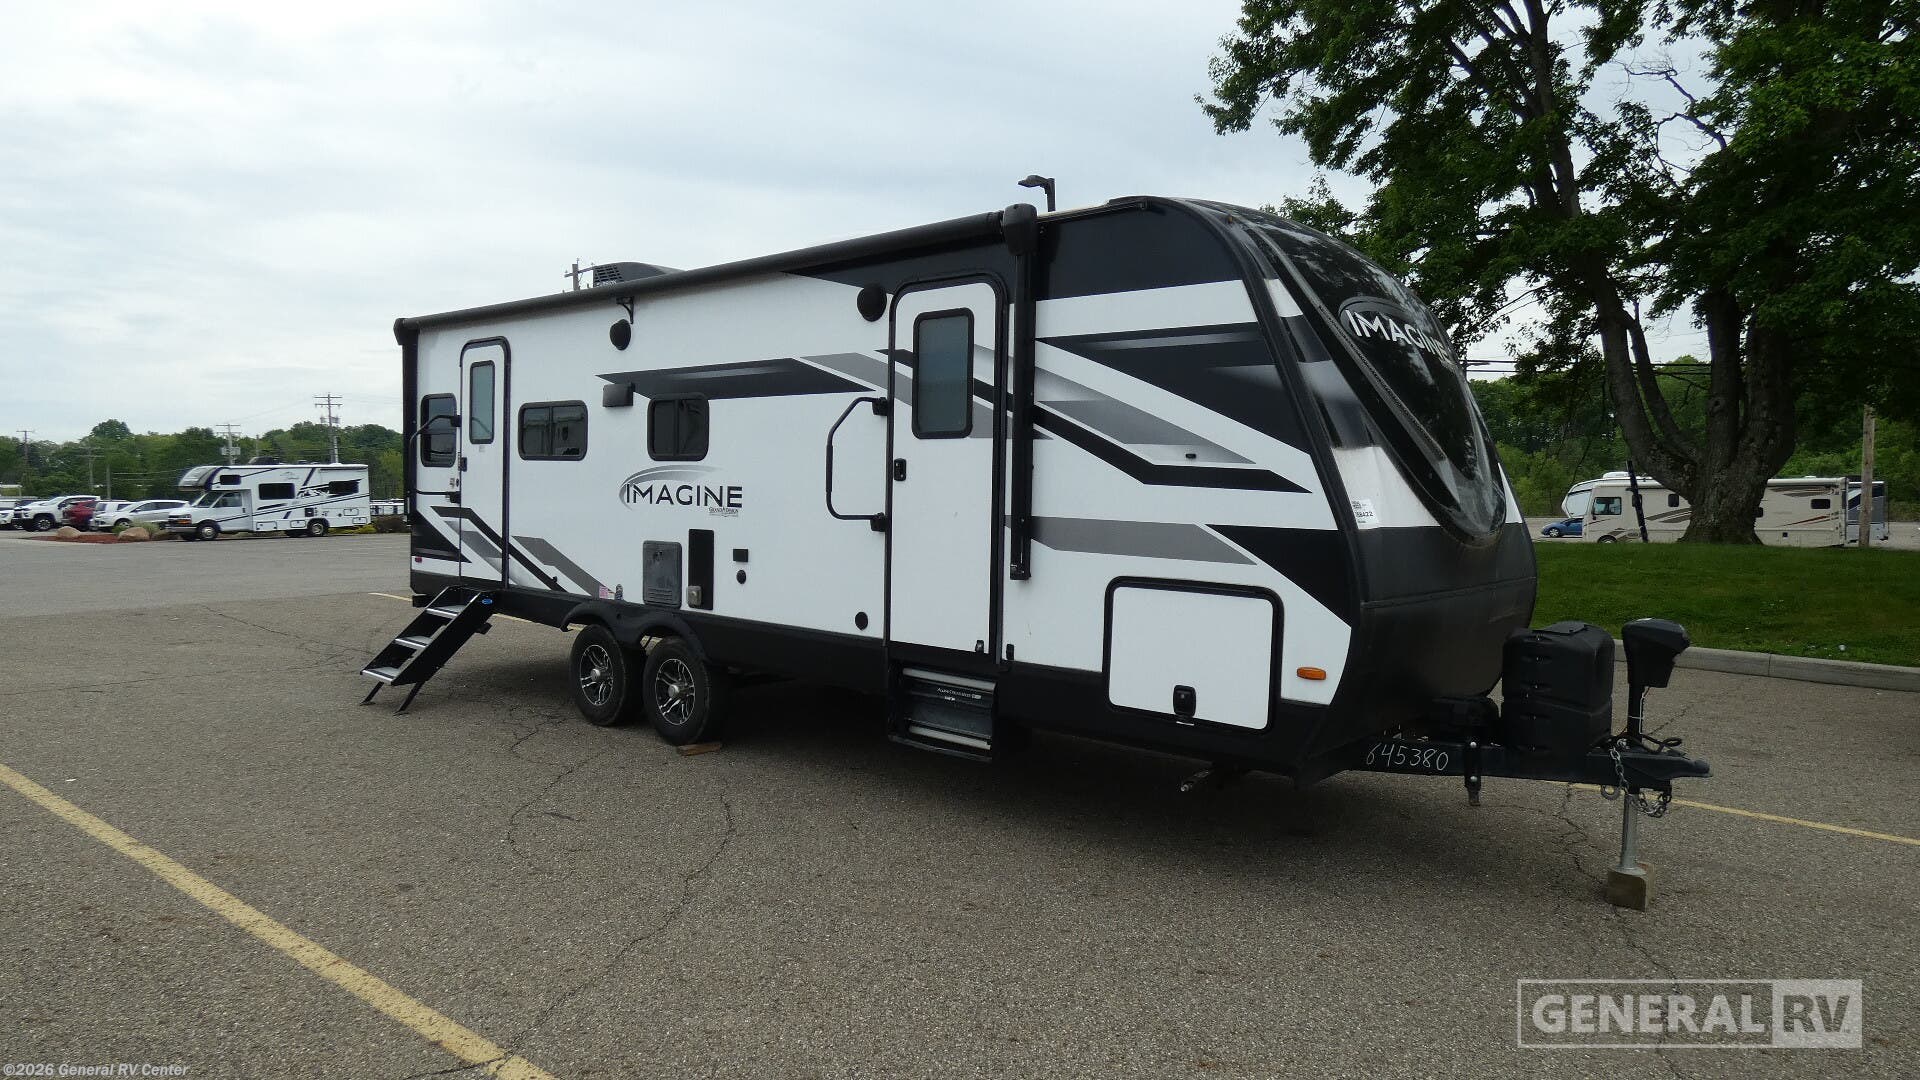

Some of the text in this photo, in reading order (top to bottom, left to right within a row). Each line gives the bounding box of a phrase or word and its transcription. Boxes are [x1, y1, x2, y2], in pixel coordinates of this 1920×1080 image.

[1345, 308, 1451, 364] IMAGINE
[625, 483, 743, 508] IMAGINE
[1366, 742, 1449, 771] 645380
